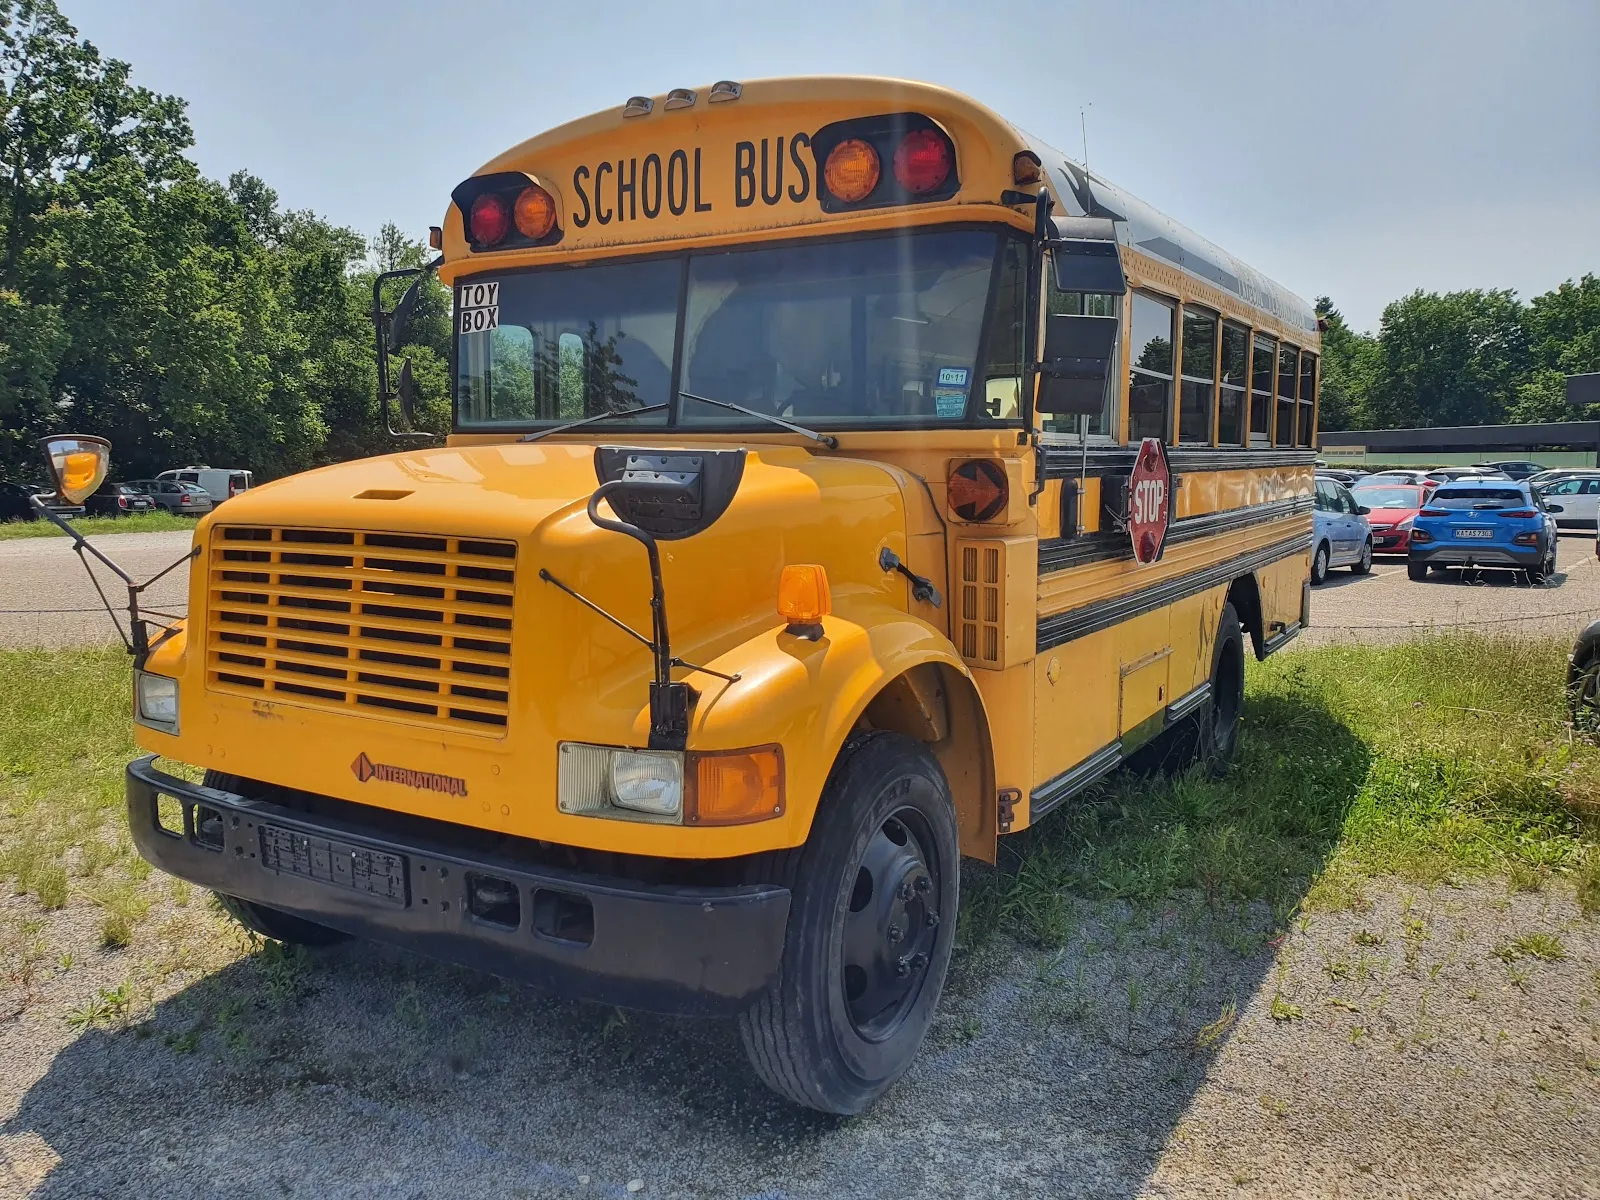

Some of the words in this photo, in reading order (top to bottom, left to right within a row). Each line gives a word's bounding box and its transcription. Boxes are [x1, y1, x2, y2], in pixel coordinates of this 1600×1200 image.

[573, 148, 712, 228] SCHOOL
[735, 132, 811, 208] BUS
[463, 283, 498, 307] TOY
[462, 307, 497, 333] BOX
[1134, 479, 1165, 525] STOP
[374, 763, 468, 797] INTERNATIONAL
